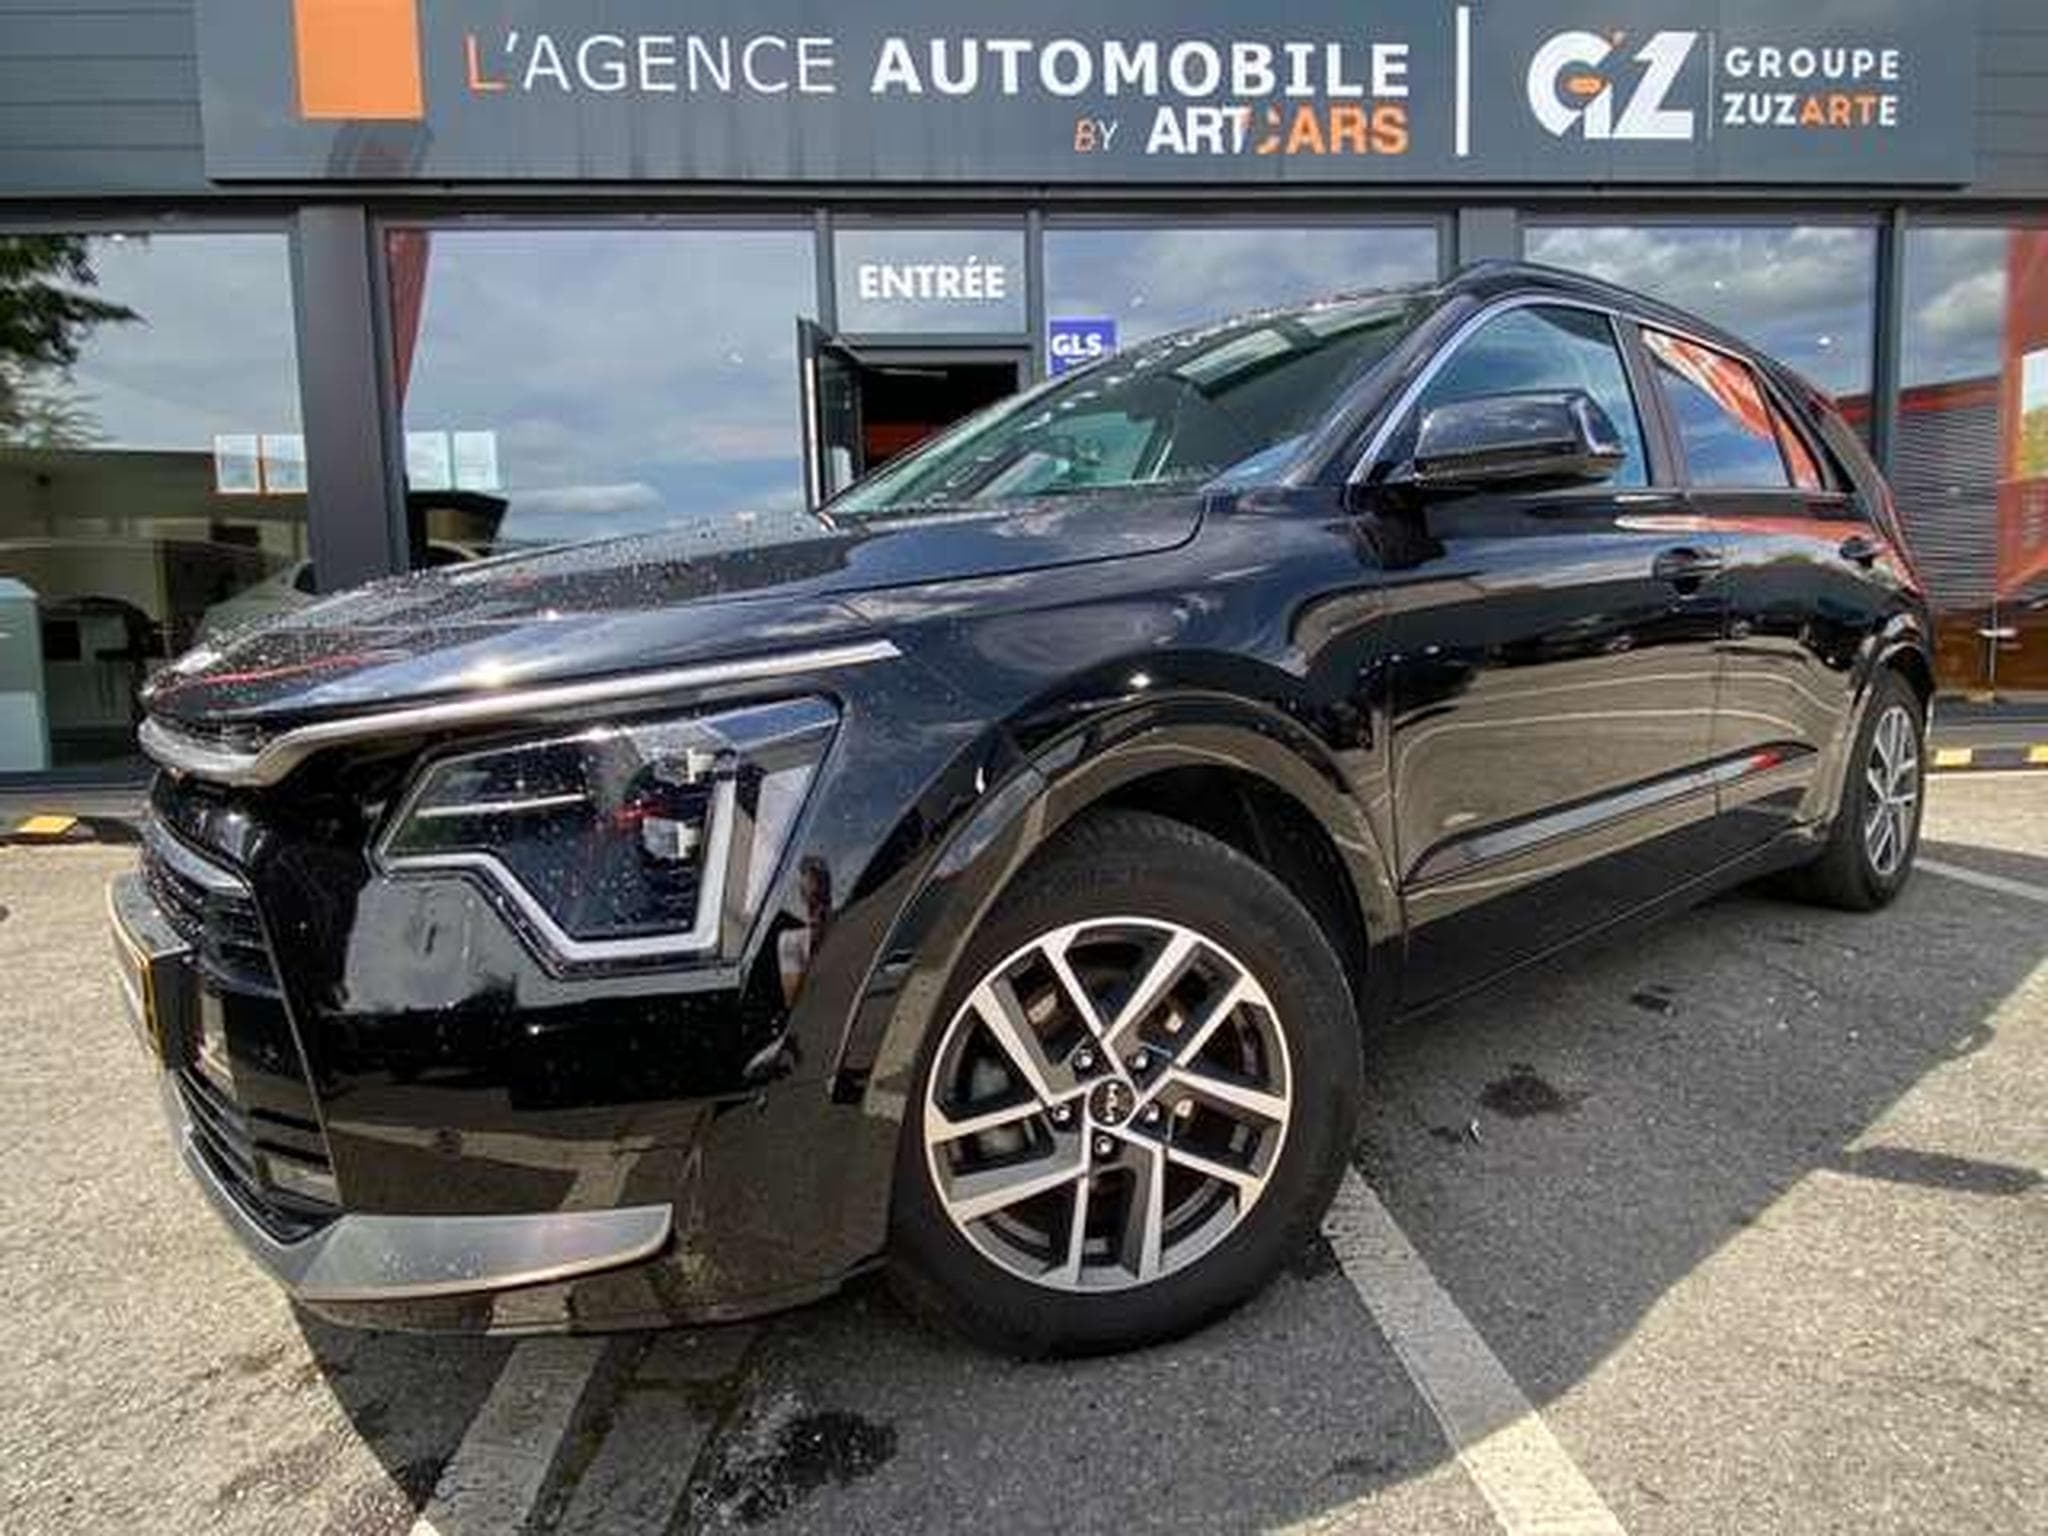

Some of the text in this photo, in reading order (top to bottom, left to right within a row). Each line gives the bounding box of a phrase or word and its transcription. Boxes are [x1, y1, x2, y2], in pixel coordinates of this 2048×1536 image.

[465, 33, 1411, 98] L'AGENCE AUTOMOBILE
[1725, 48, 1901, 80] GROUPE
[1723, 94, 1899, 128] ZUZARTE
[1073, 121, 1118, 153] BY
[859, 256, 1007, 299] ENTRÉE
